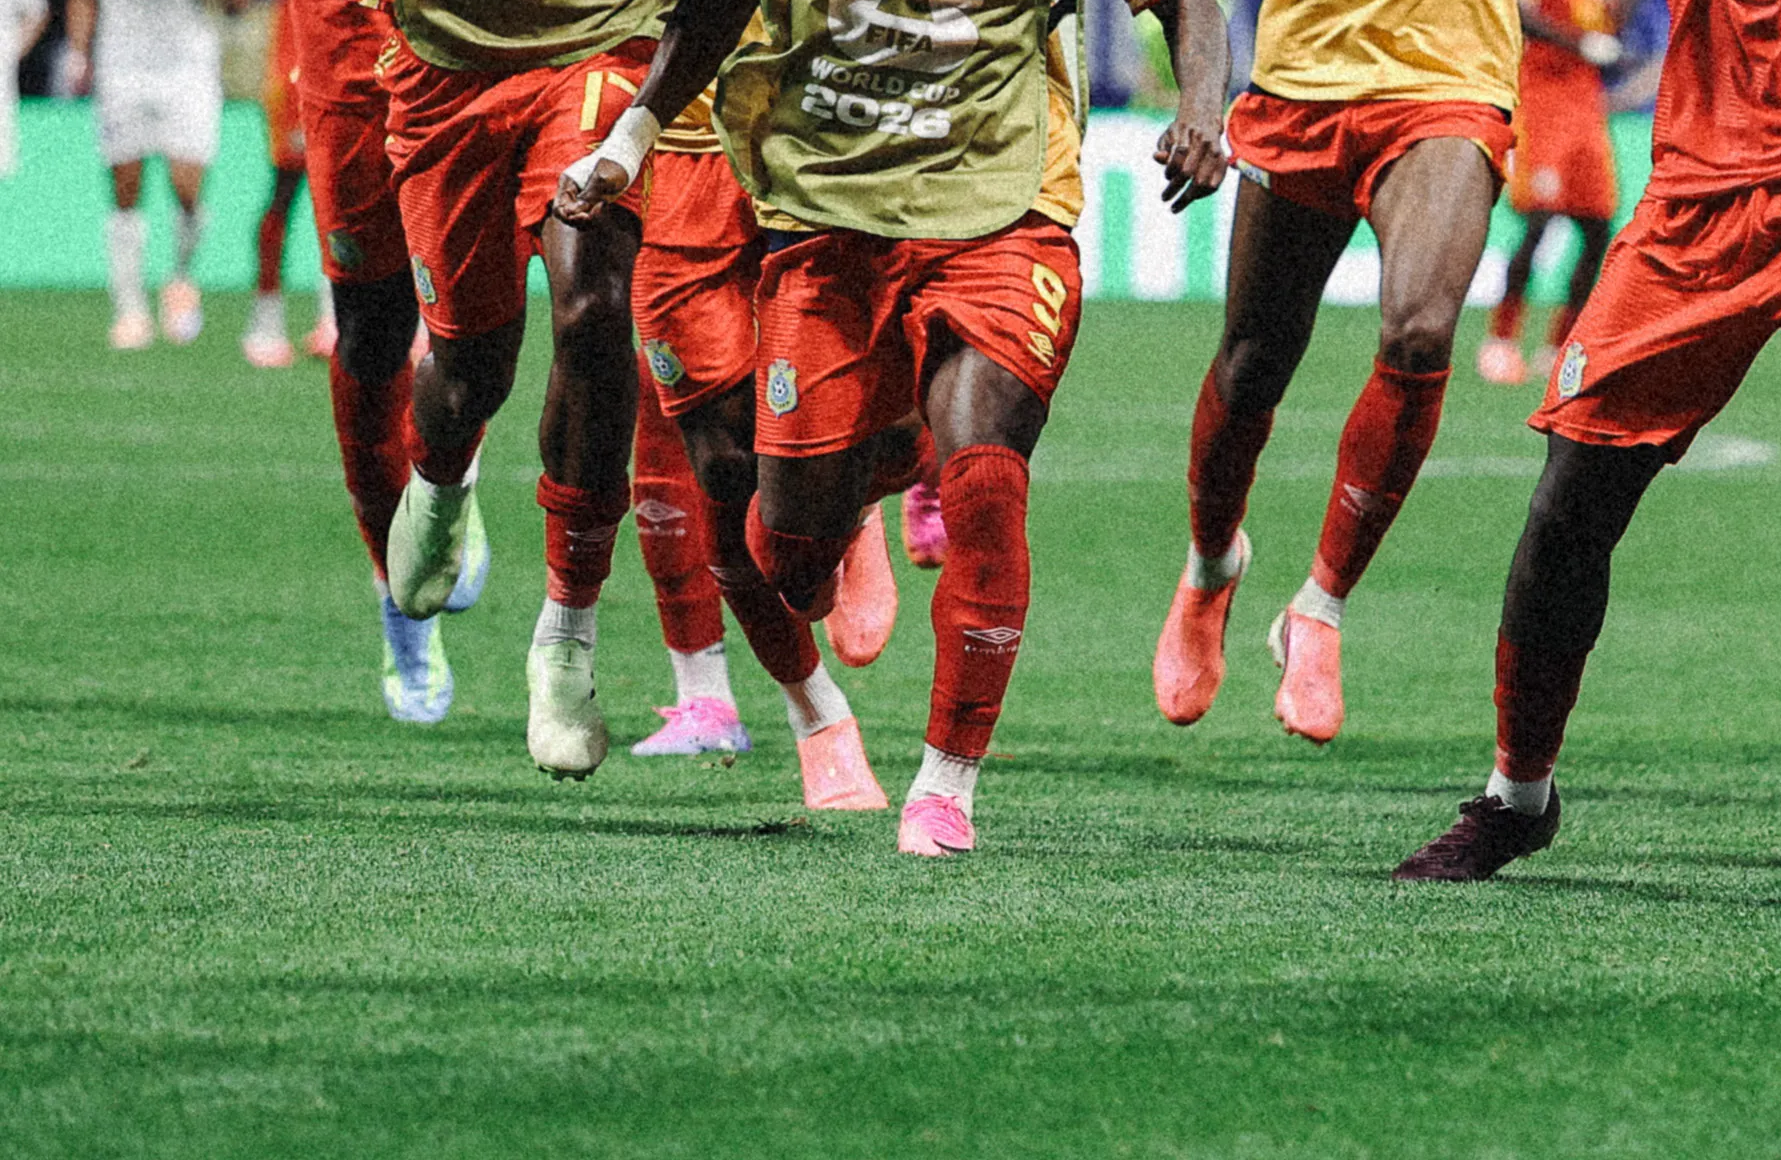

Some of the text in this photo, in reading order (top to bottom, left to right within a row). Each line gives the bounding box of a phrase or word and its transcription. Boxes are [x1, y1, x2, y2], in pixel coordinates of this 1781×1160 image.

[866, 23, 932, 53] FIFA
[811, 57, 960, 105] WORLD CUP
[801, 83, 952, 139] 2026
